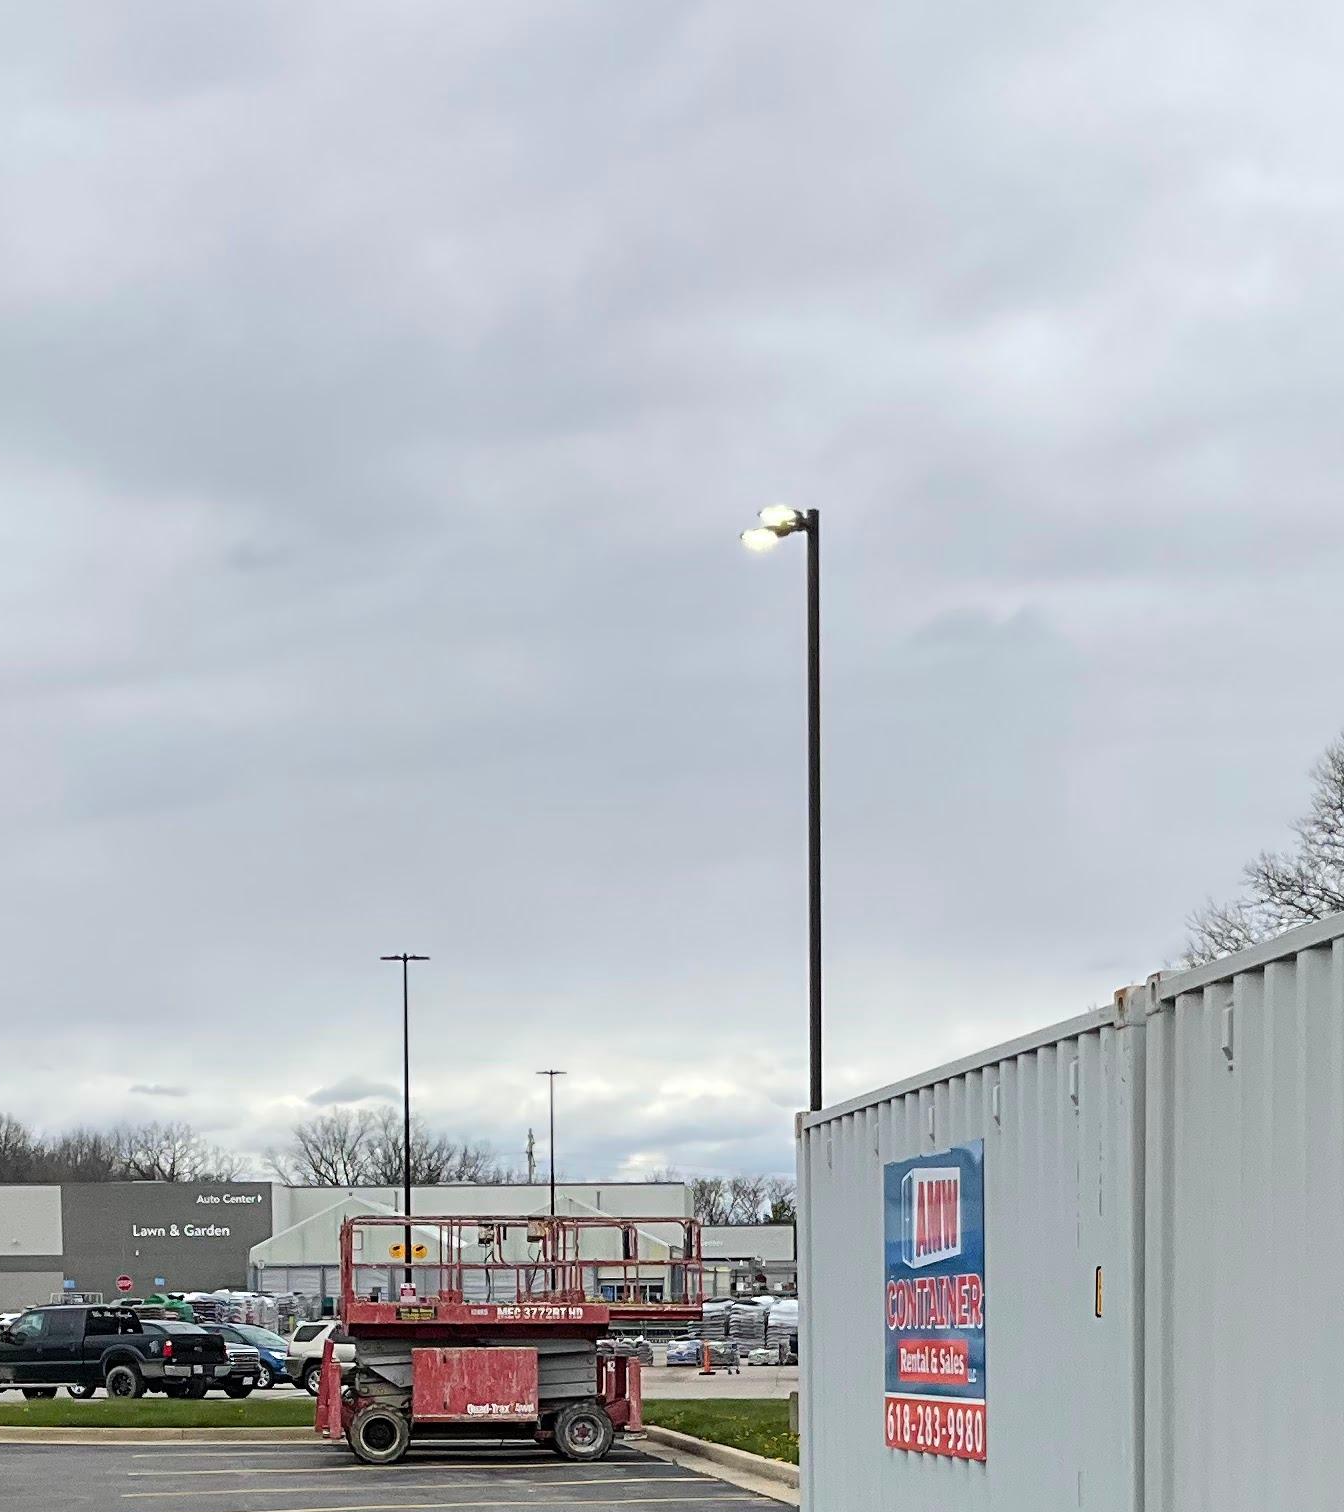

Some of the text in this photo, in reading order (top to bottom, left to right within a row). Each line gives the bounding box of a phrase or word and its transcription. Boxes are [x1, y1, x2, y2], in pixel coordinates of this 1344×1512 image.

[196, 1194, 256, 1204] Auto Center
[132, 1224, 231, 1237] Lawn & Garden
[916, 1179, 957, 1257] AMW
[497, 1307, 521, 1319] MEC
[886, 1273, 984, 1329] CONTAINER
[900, 1346, 965, 1375] Rental & Sales
[886, 1402, 983, 1453] 618-283-9980
